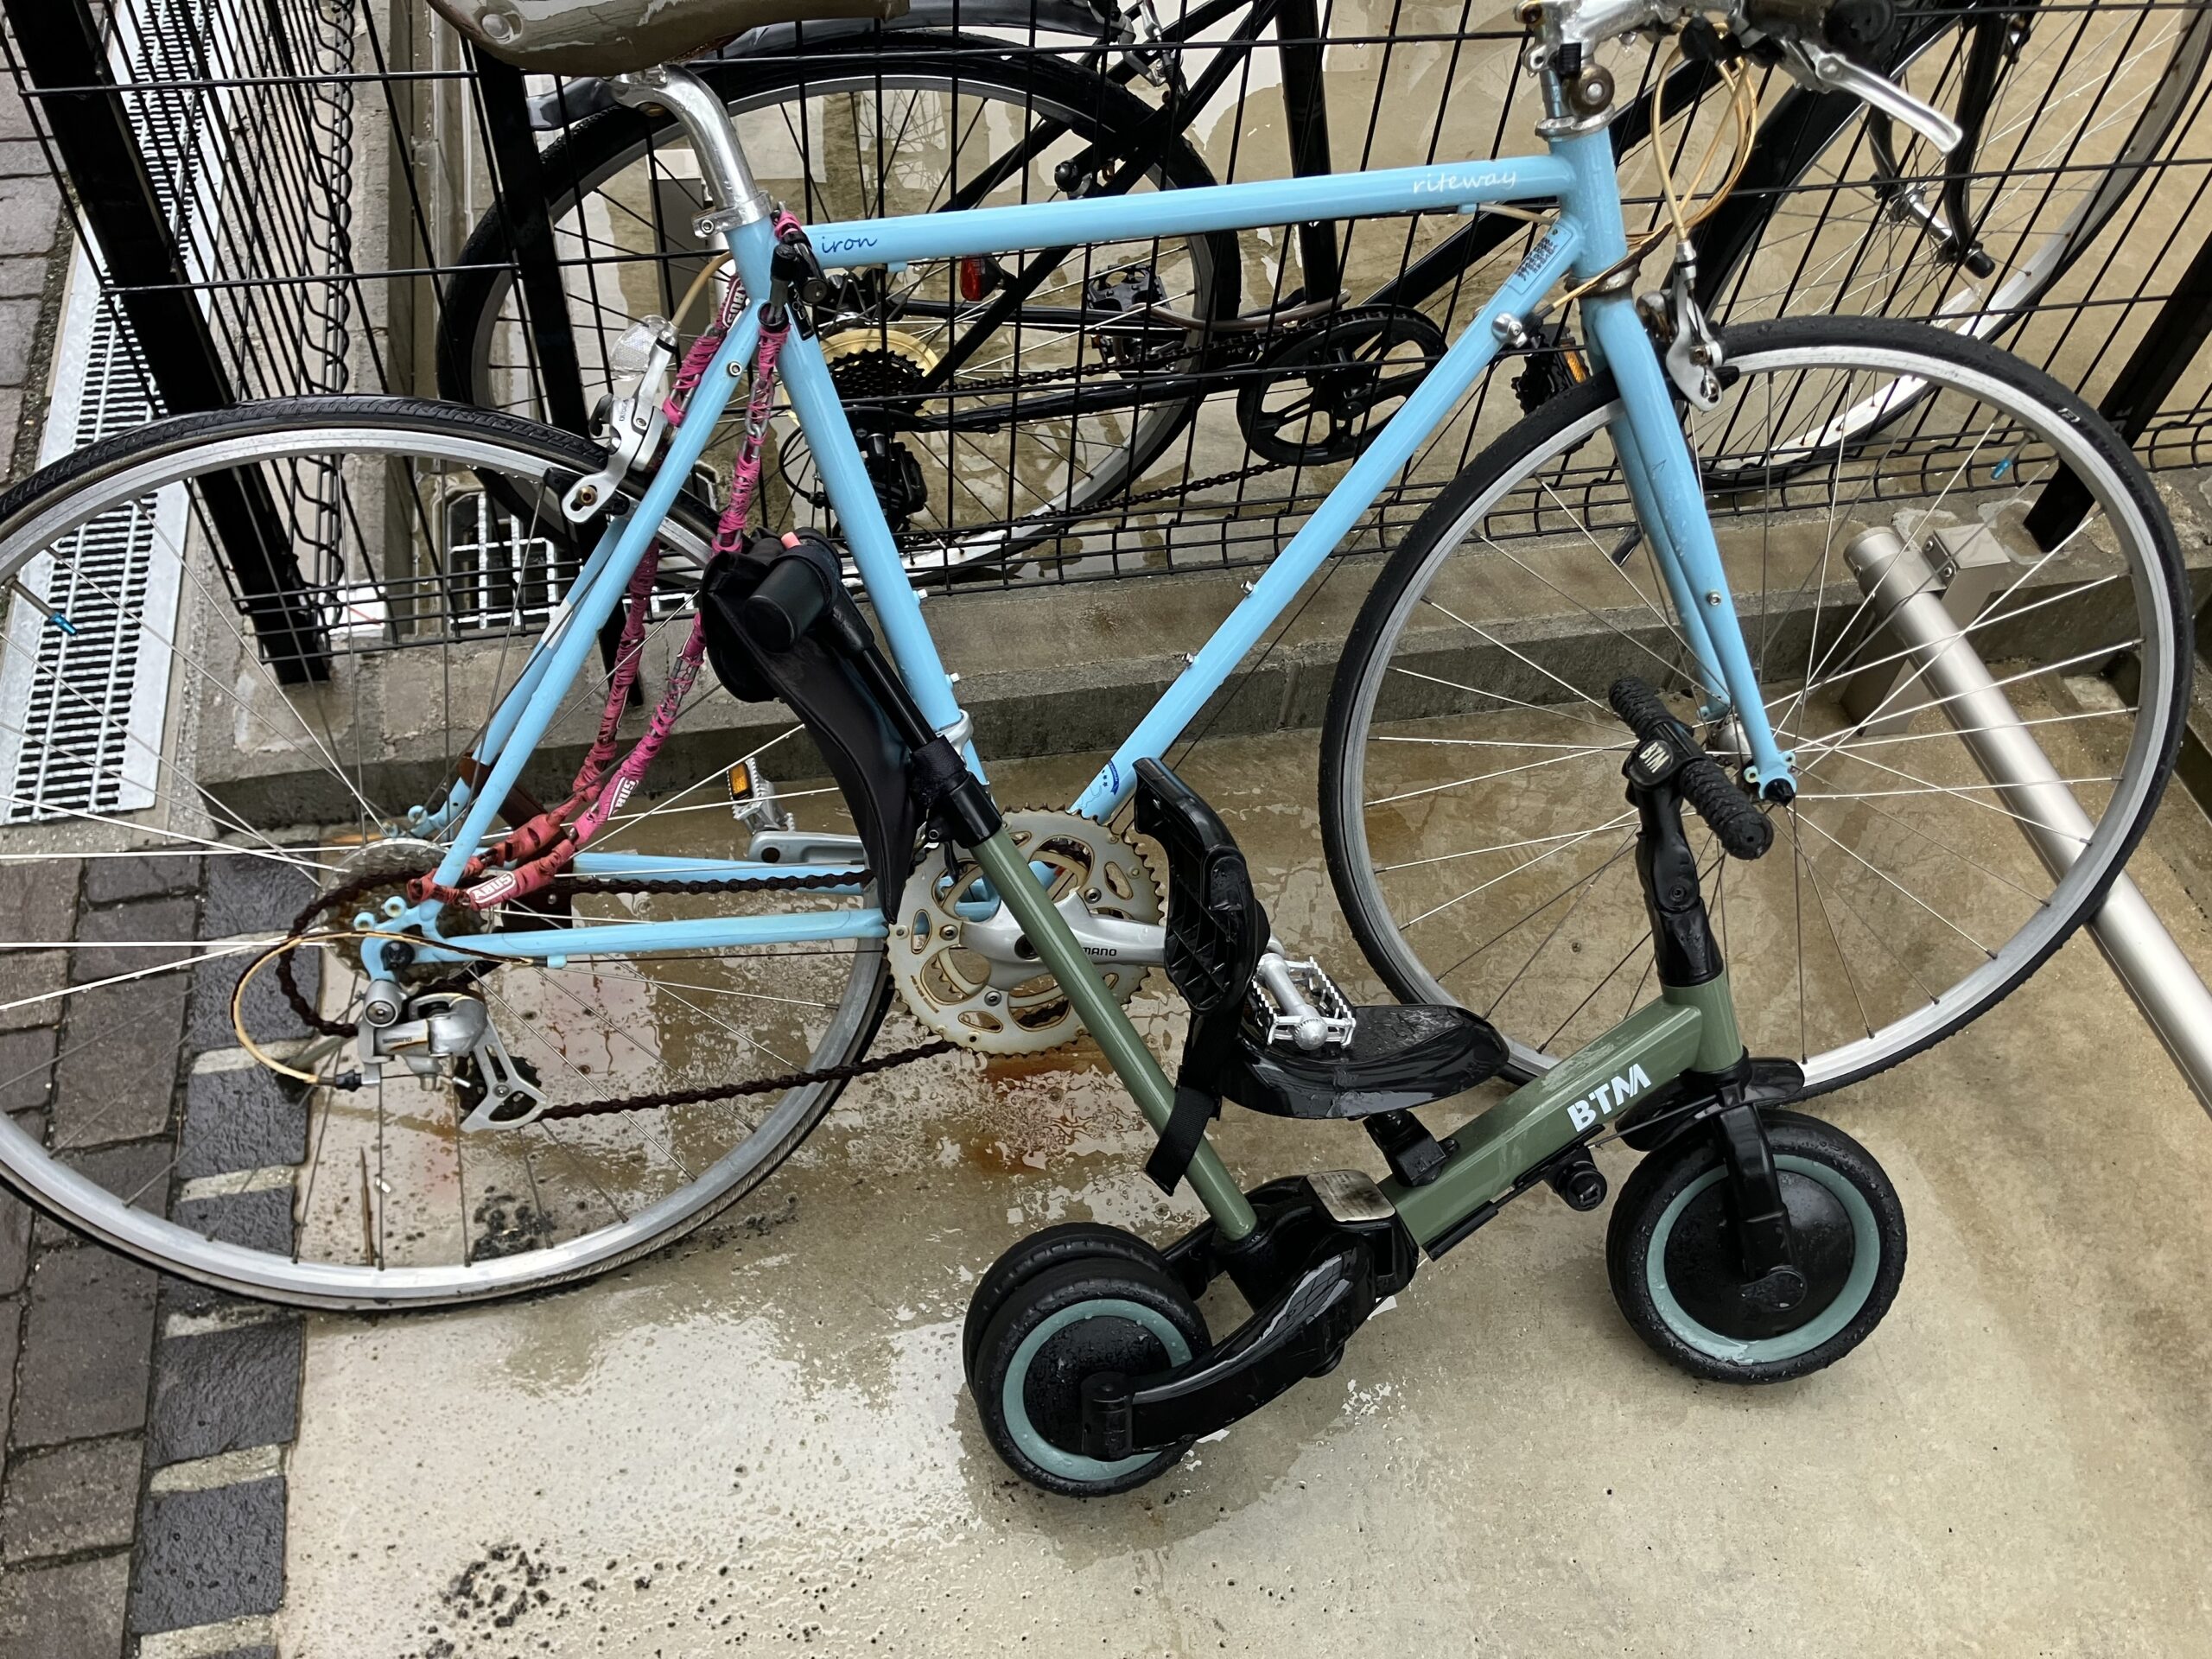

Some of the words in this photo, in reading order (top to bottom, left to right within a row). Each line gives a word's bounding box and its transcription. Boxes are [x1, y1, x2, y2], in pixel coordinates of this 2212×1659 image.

[1413, 171, 1516, 194] riteway
[822, 236, 878, 253] iron
[1639, 741, 1670, 774] BTM
[612, 779, 638, 814] BUS
[473, 873, 512, 900] ABUS
[1083, 947, 1117, 957] MANO
[1567, 1063, 1652, 1133] BTM
